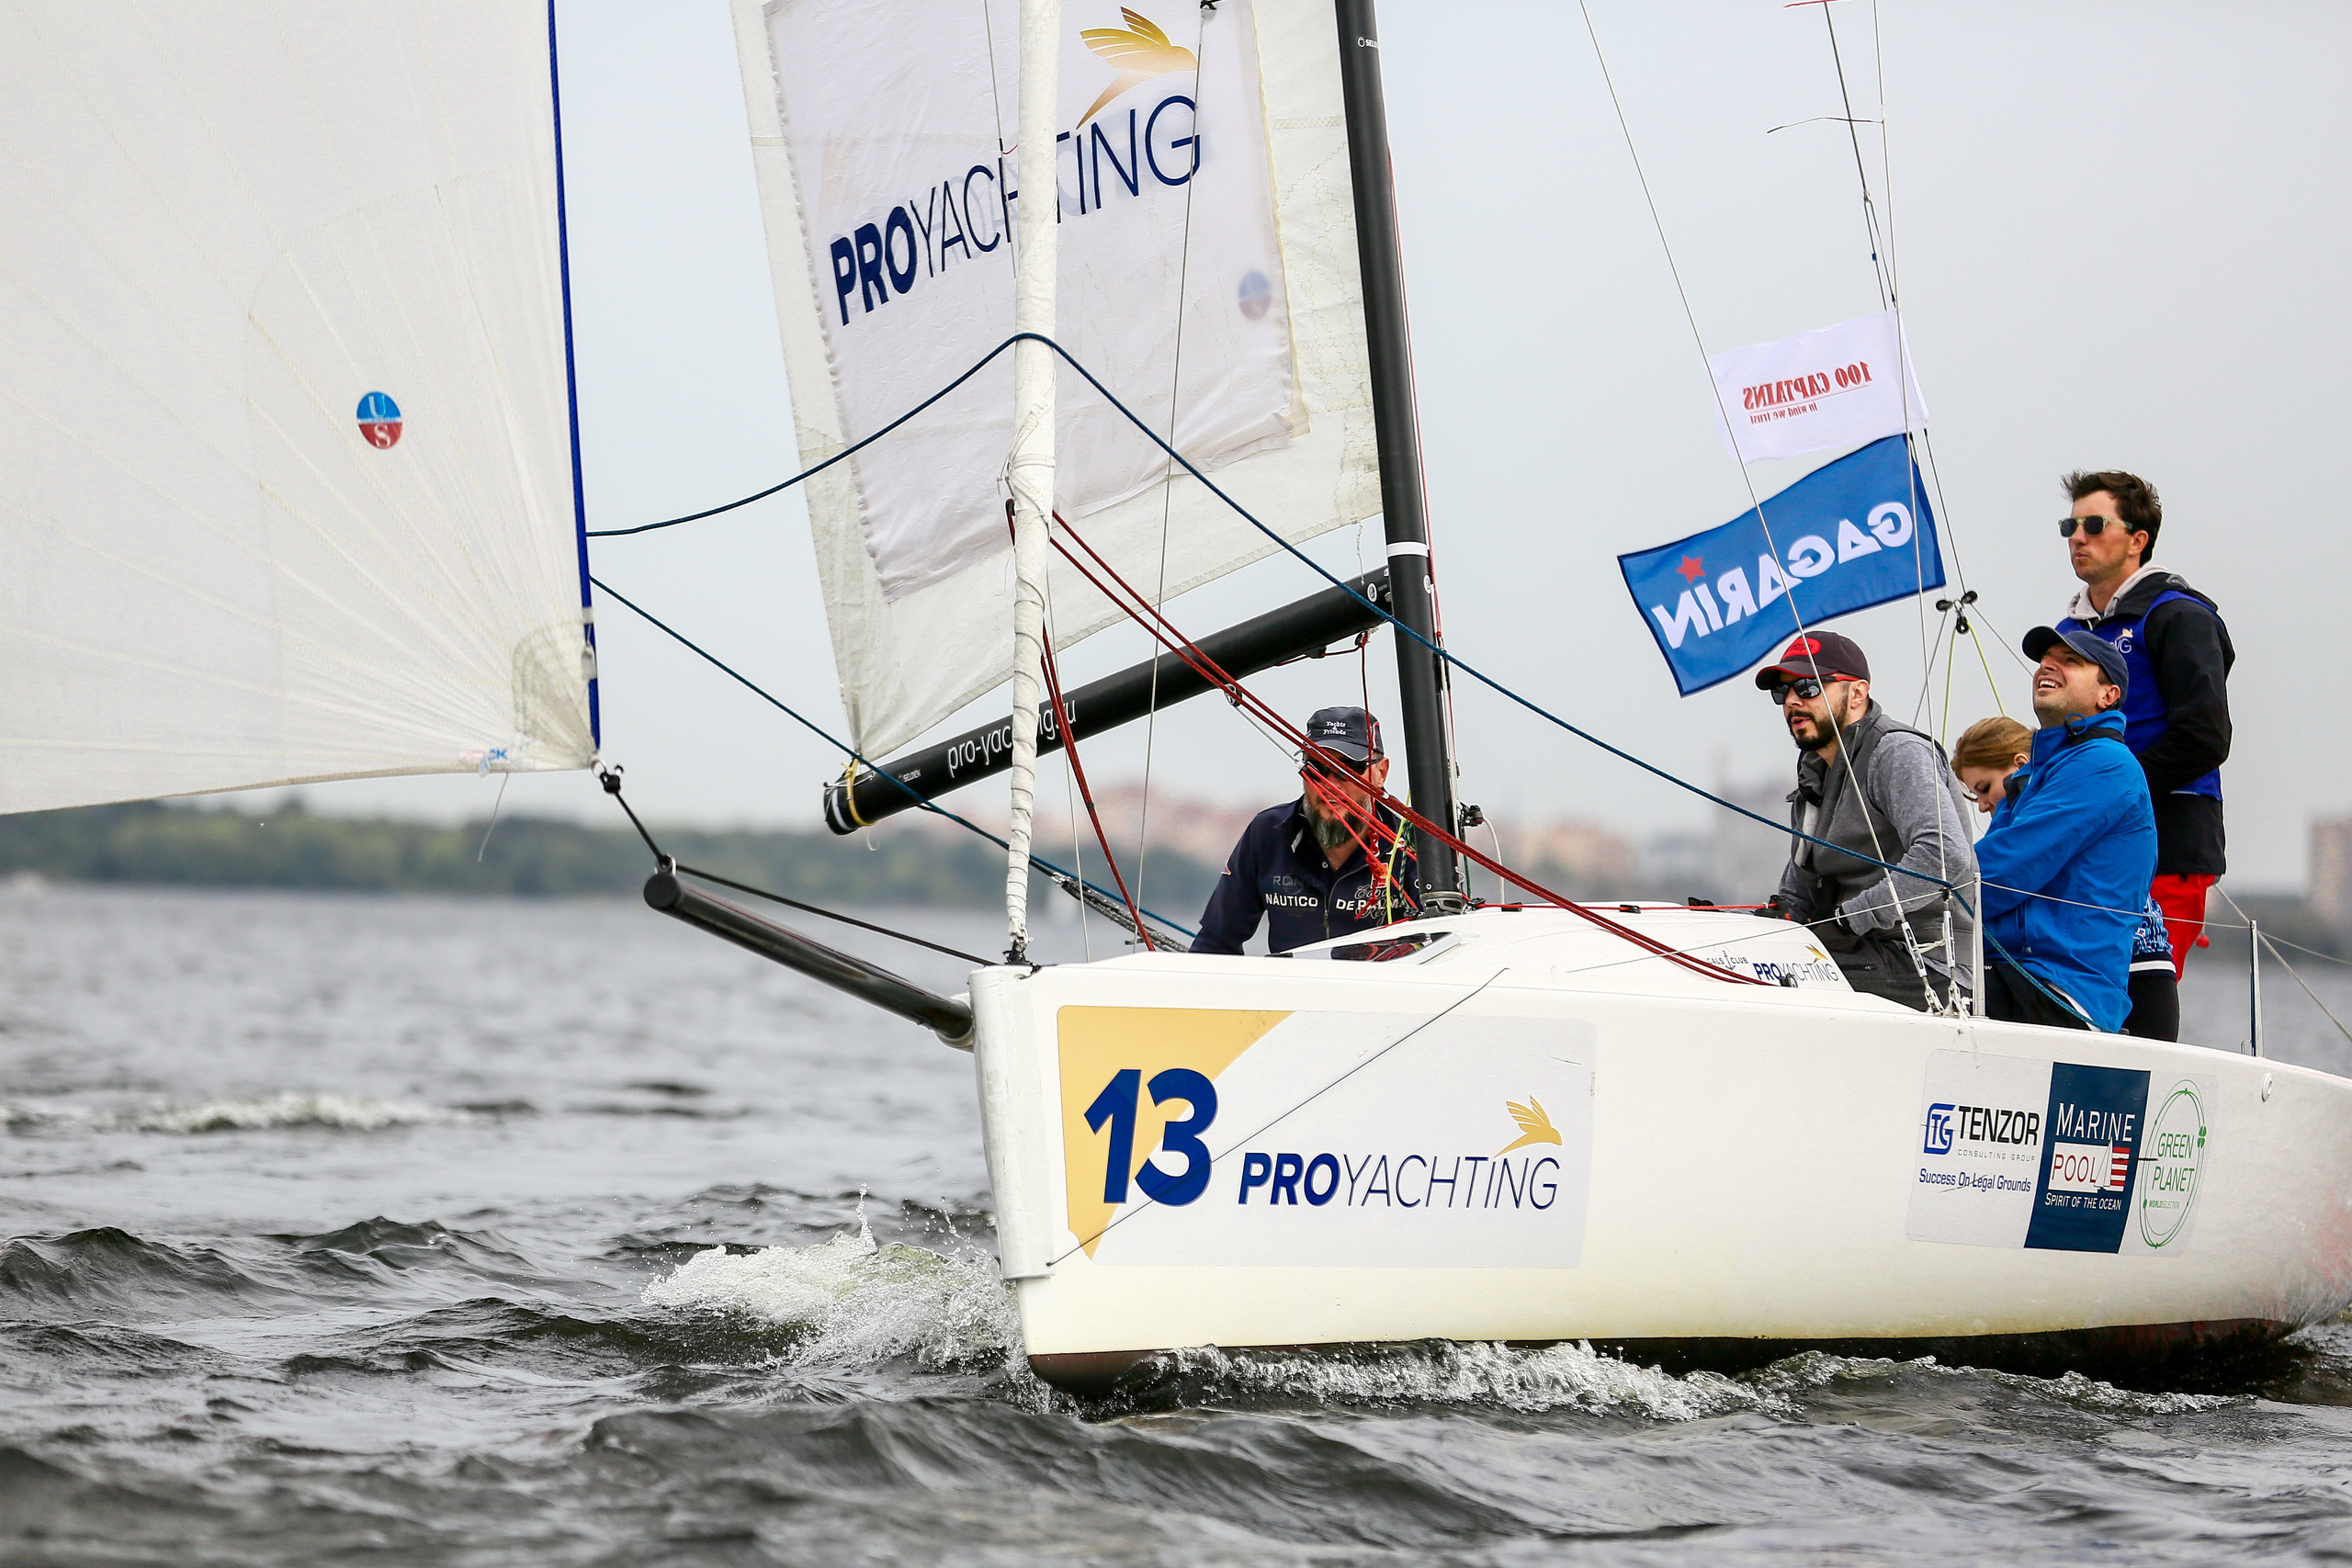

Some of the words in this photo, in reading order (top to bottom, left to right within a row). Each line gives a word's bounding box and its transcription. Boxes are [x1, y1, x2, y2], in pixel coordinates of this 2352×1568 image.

[1265, 893, 1318, 908] NÁUTICO
[1336, 898, 1355, 911] DE
[1730, 956, 1749, 964] CLUB
[1084, 1067, 1218, 1207] 13
[1958, 1105, 2041, 1146] TENZOR
[1958, 1148, 2007, 1160] CONSULTING
[2010, 1154, 2036, 1162] GROUP
[2156, 1132, 2195, 1159] GREEN
[1238, 1152, 1561, 1211] PROYACHTING
[1919, 1168, 1957, 1184] Success
[1958, 1171, 1971, 1188] On
[1972, 1172, 1996, 1193] Legal
[1996, 1175, 2031, 1192] Grounds
[2051, 1153, 2097, 1184] POOL
[2151, 1166, 2196, 1192] PLANET
[2071, 1196, 2083, 1208] OF
[2084, 1197, 2098, 1210] THE
[2098, 1198, 2122, 1211] OCEAN
